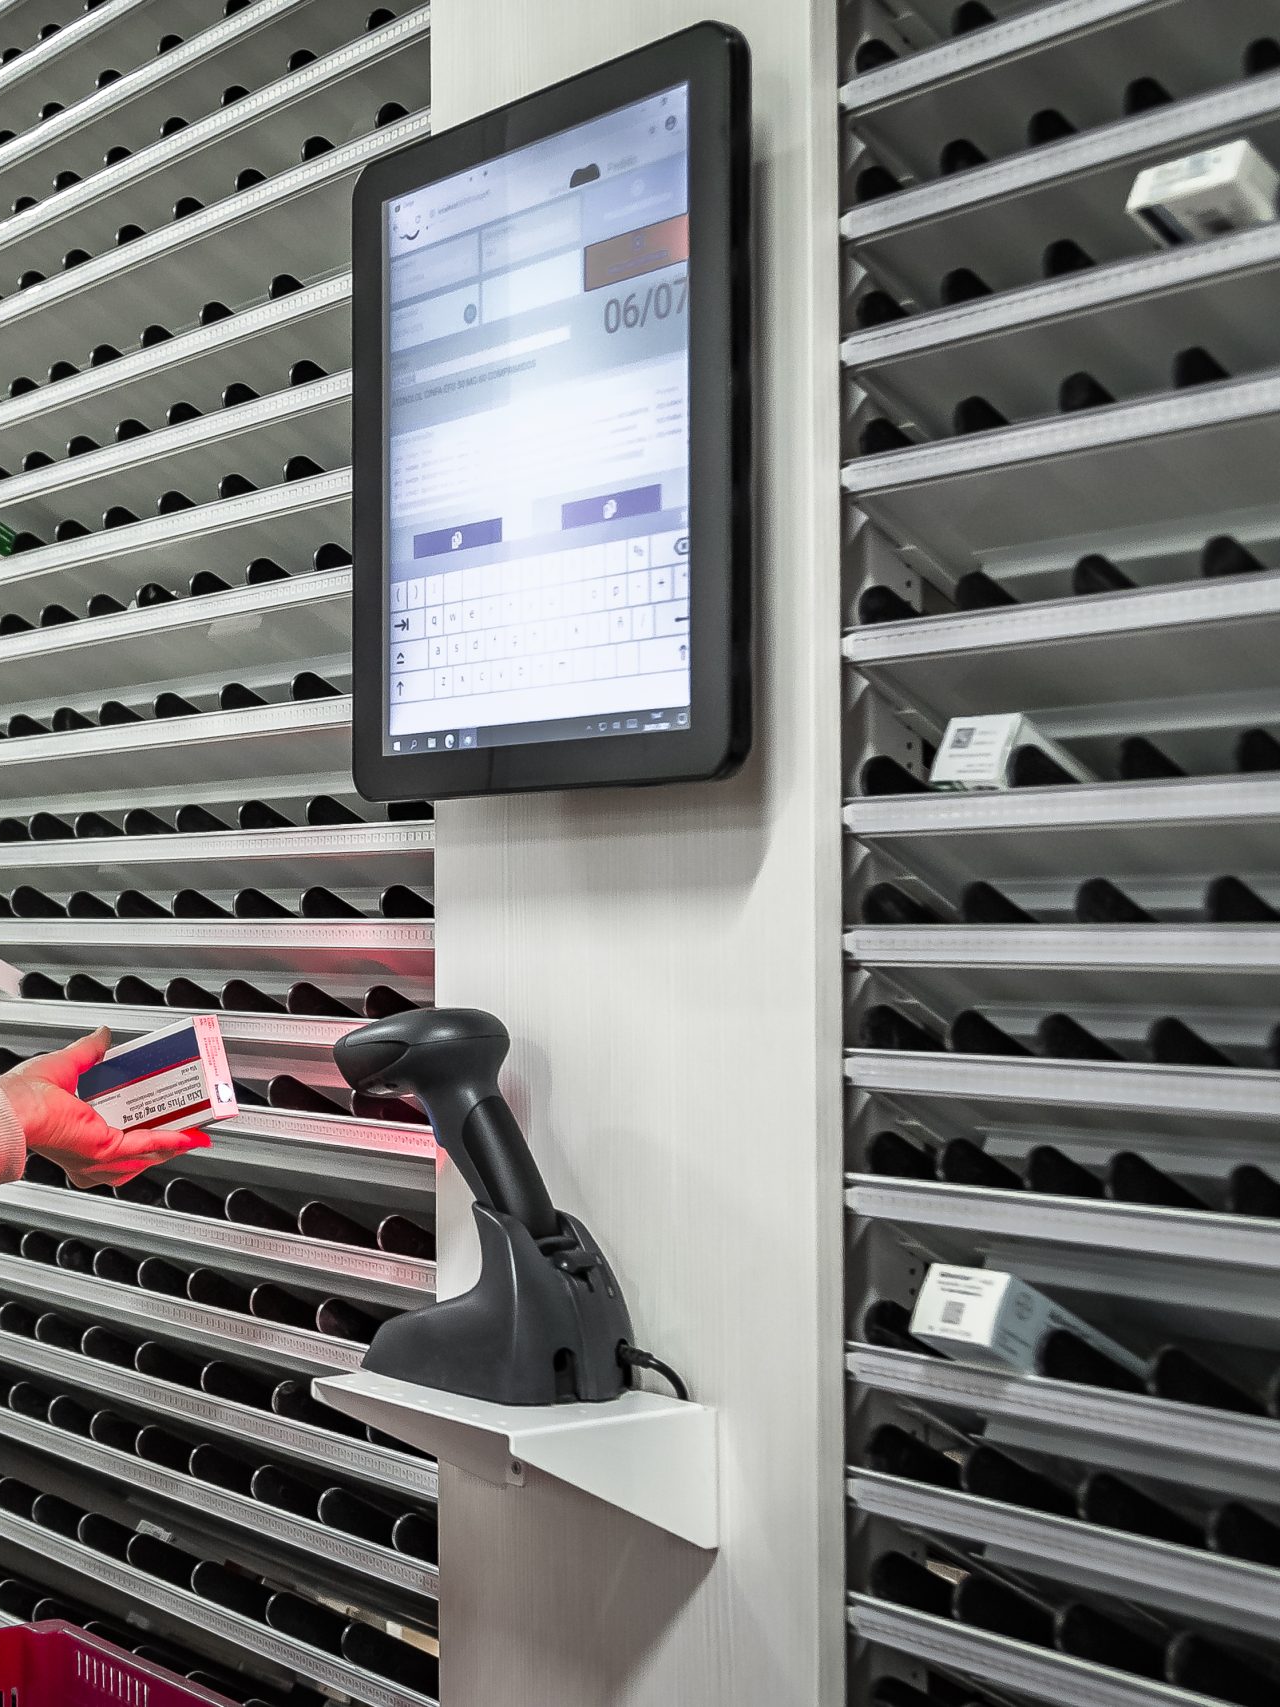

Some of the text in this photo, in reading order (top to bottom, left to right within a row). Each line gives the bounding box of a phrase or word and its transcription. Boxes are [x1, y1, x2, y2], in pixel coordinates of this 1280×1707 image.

[604, 277, 688, 334] 06/07
[186, 1089, 203, 1101] Ixia
[167, 1096, 186, 1107] Plus
[134, 1106, 156, 1120] mg/25
[157, 1103, 167, 1112] 20
[122, 1114, 134, 1124] mg
